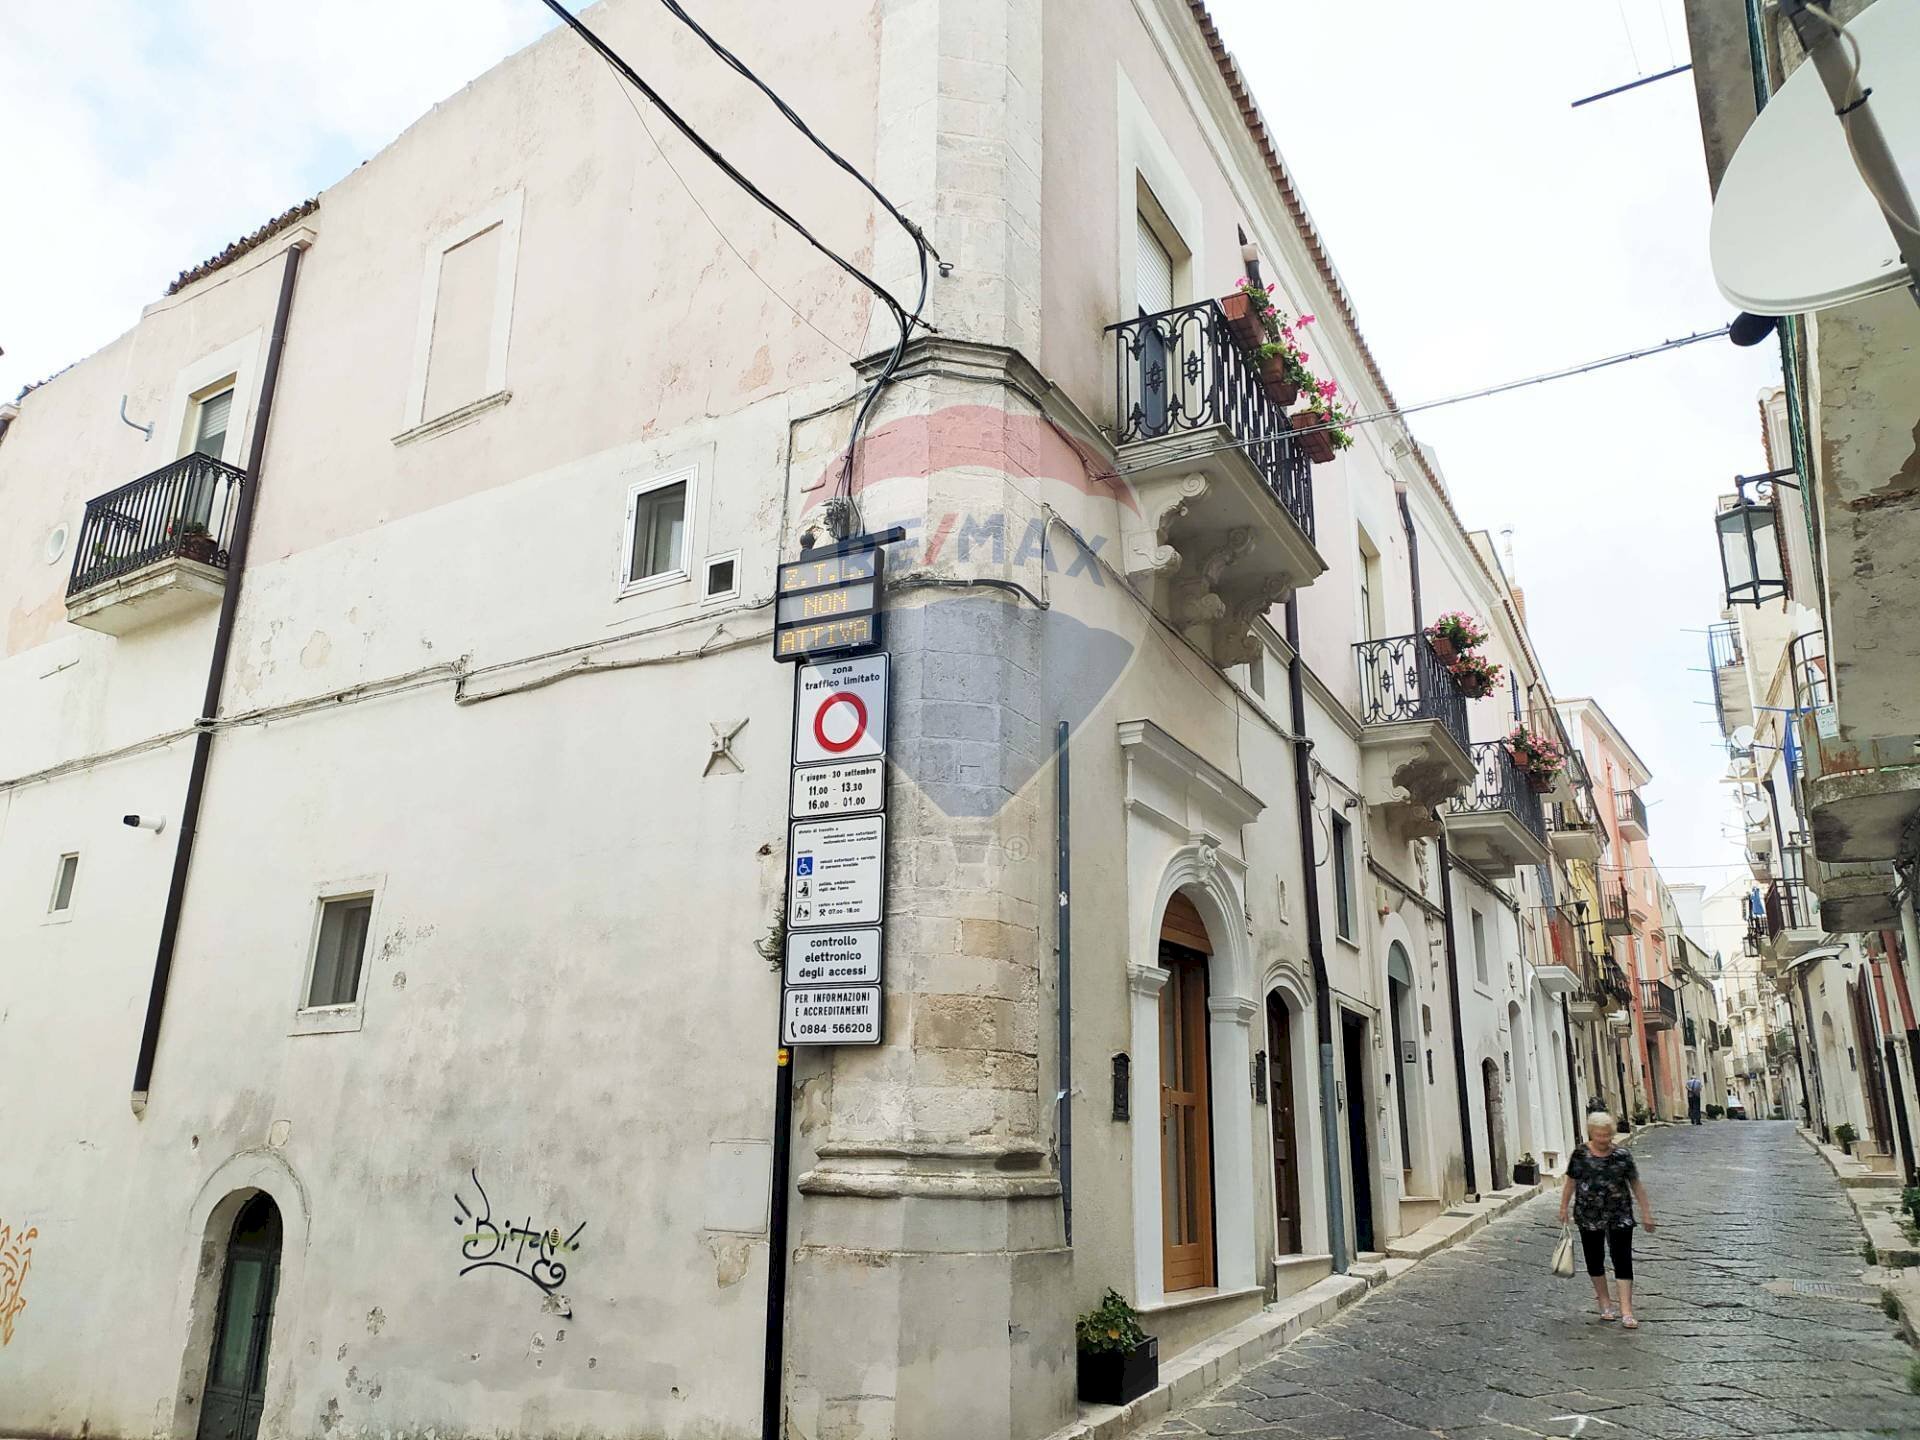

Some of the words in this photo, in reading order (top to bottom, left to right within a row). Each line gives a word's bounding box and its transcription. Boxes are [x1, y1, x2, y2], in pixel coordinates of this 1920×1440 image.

[783, 559, 864, 590] Z.T.L.
[781, 619, 868, 652] ATTIVA
[832, 665, 853, 675] zona
[805, 679, 840, 690] traffico
[843, 673, 880, 685] limitato
[844, 767, 876, 777] settembre
[808, 786, 828, 796] 11.00
[808, 800, 829, 810] 16.00
[843, 796, 866, 807] 01.00
[810, 935, 857, 947] controllo
[805, 951, 862, 962] elettronico
[799, 967, 824, 979] degli
[828, 965, 866, 976] accessi
[795, 994, 808, 1003] PER
[813, 992, 870, 1003] INFORMAZIONI
[795, 1007, 799, 1016] E
[803, 1005, 869, 1016] ACCREDITAMENTI
[800, 1024, 827, 1034] 0884
[832, 1022, 872, 1033] 566208
